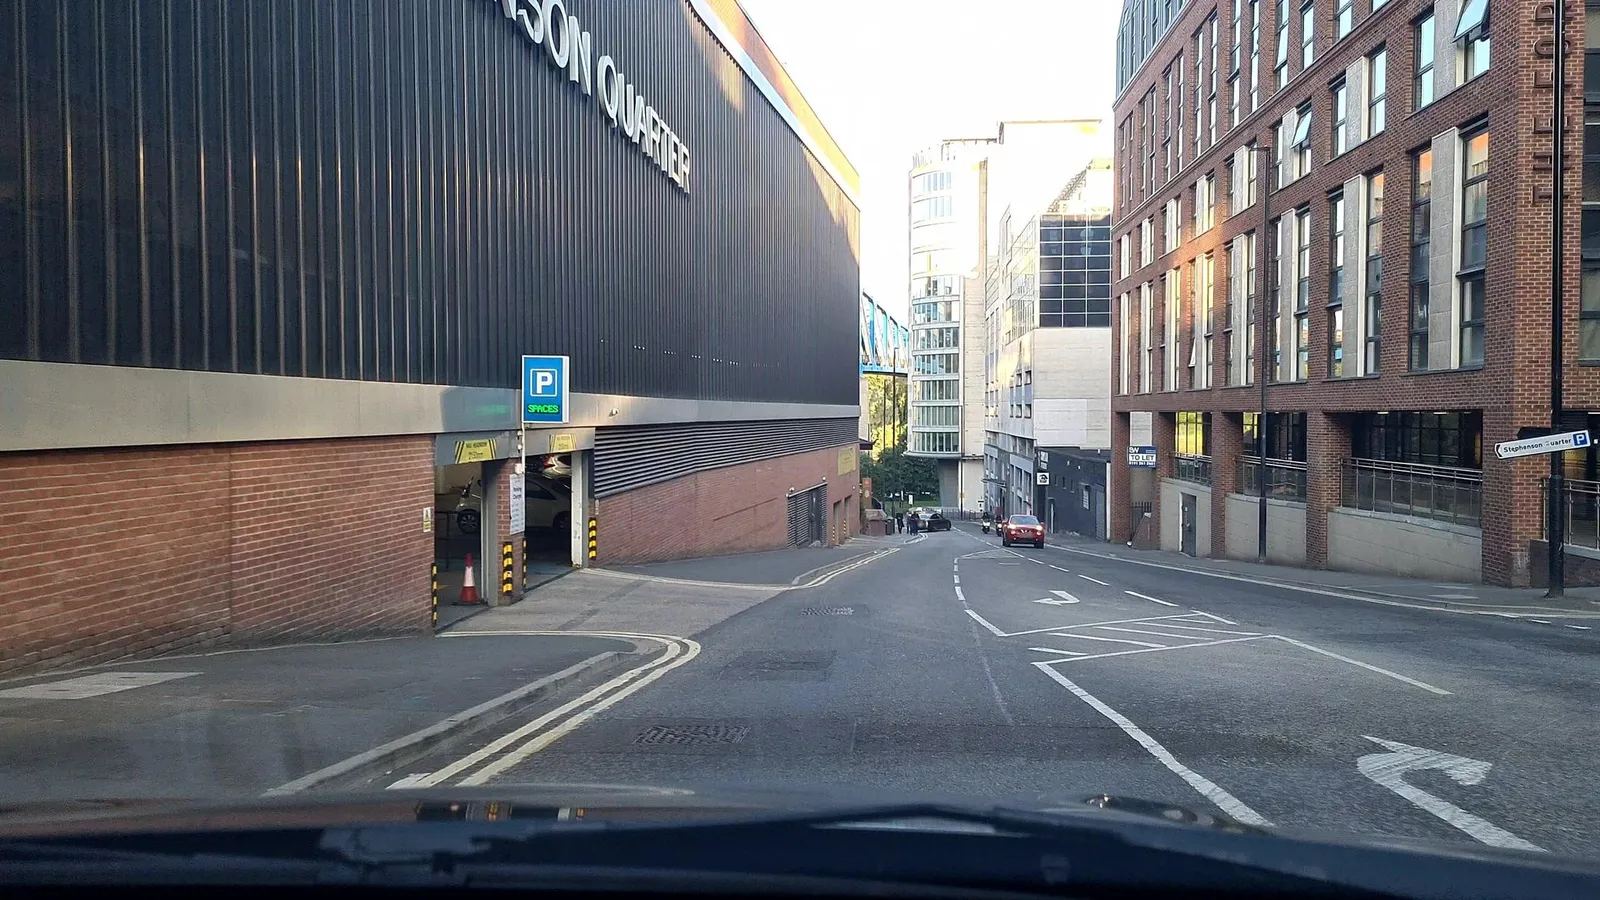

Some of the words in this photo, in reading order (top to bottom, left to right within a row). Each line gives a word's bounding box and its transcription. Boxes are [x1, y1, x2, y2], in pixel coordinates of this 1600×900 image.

[597, 55, 690, 194] QUARTER
[536, 371, 553, 394] P
[527, 404, 559, 413] SPACES
[1503, 443, 1543, 453] Stephenson
[1576, 433, 1585, 444] P
